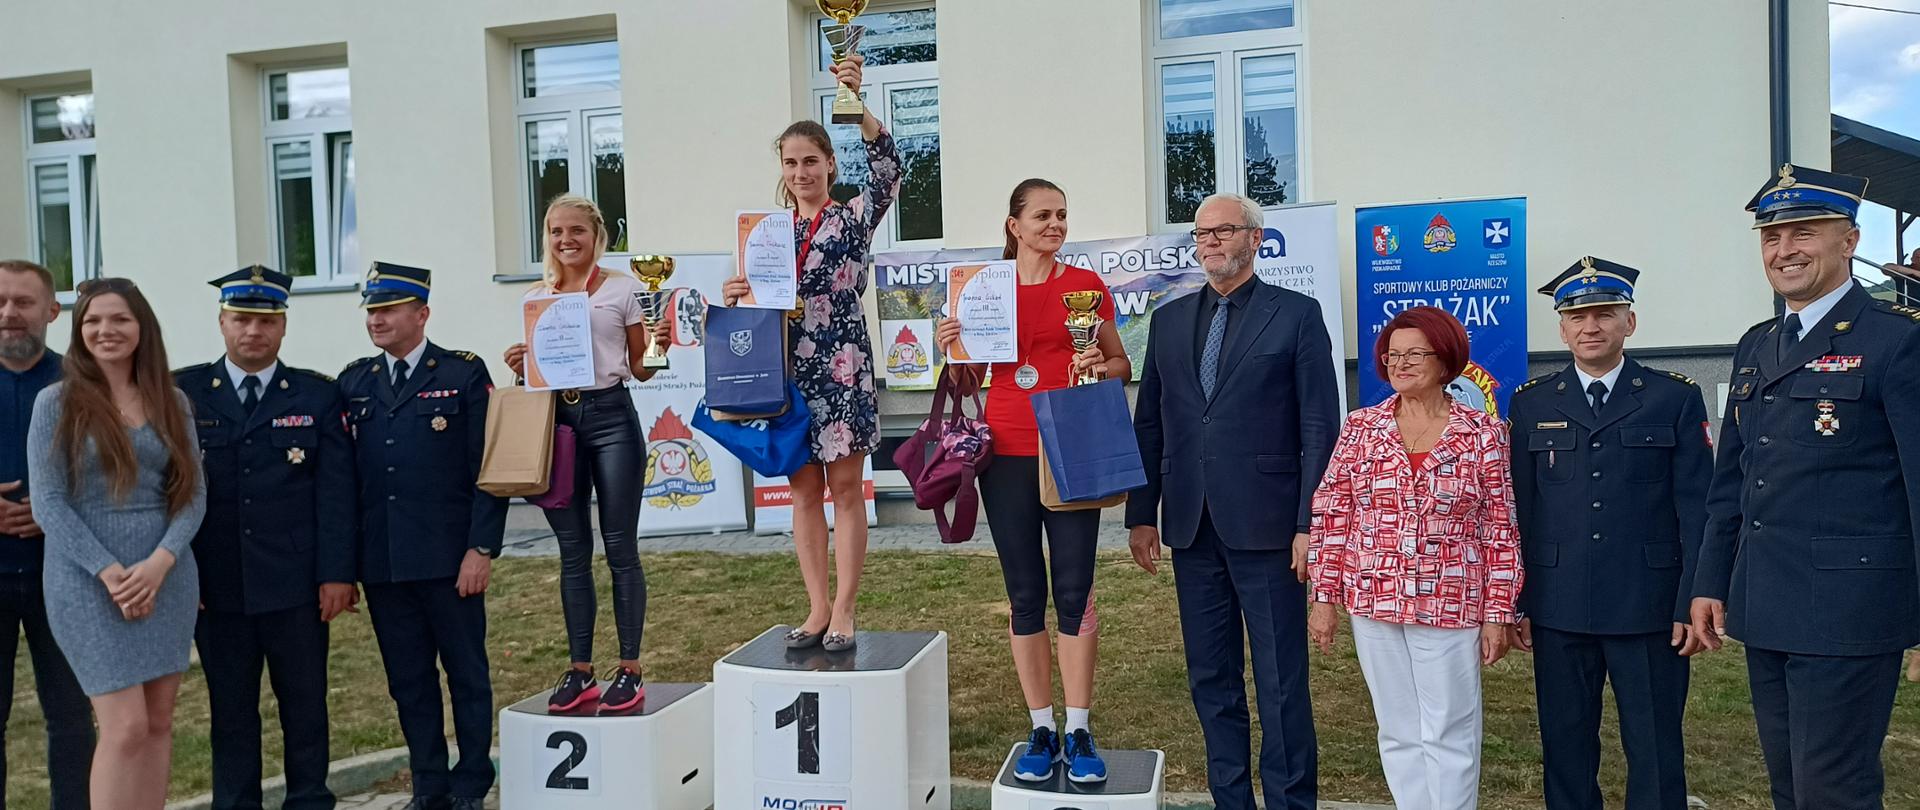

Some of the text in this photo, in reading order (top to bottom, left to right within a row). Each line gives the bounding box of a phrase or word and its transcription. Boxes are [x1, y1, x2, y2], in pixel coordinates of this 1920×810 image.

[1373, 277, 1508, 295] SPORTOWY KLUB POŻARNICZY
[545, 730, 590, 790] 2
[775, 691, 820, 774] 1
